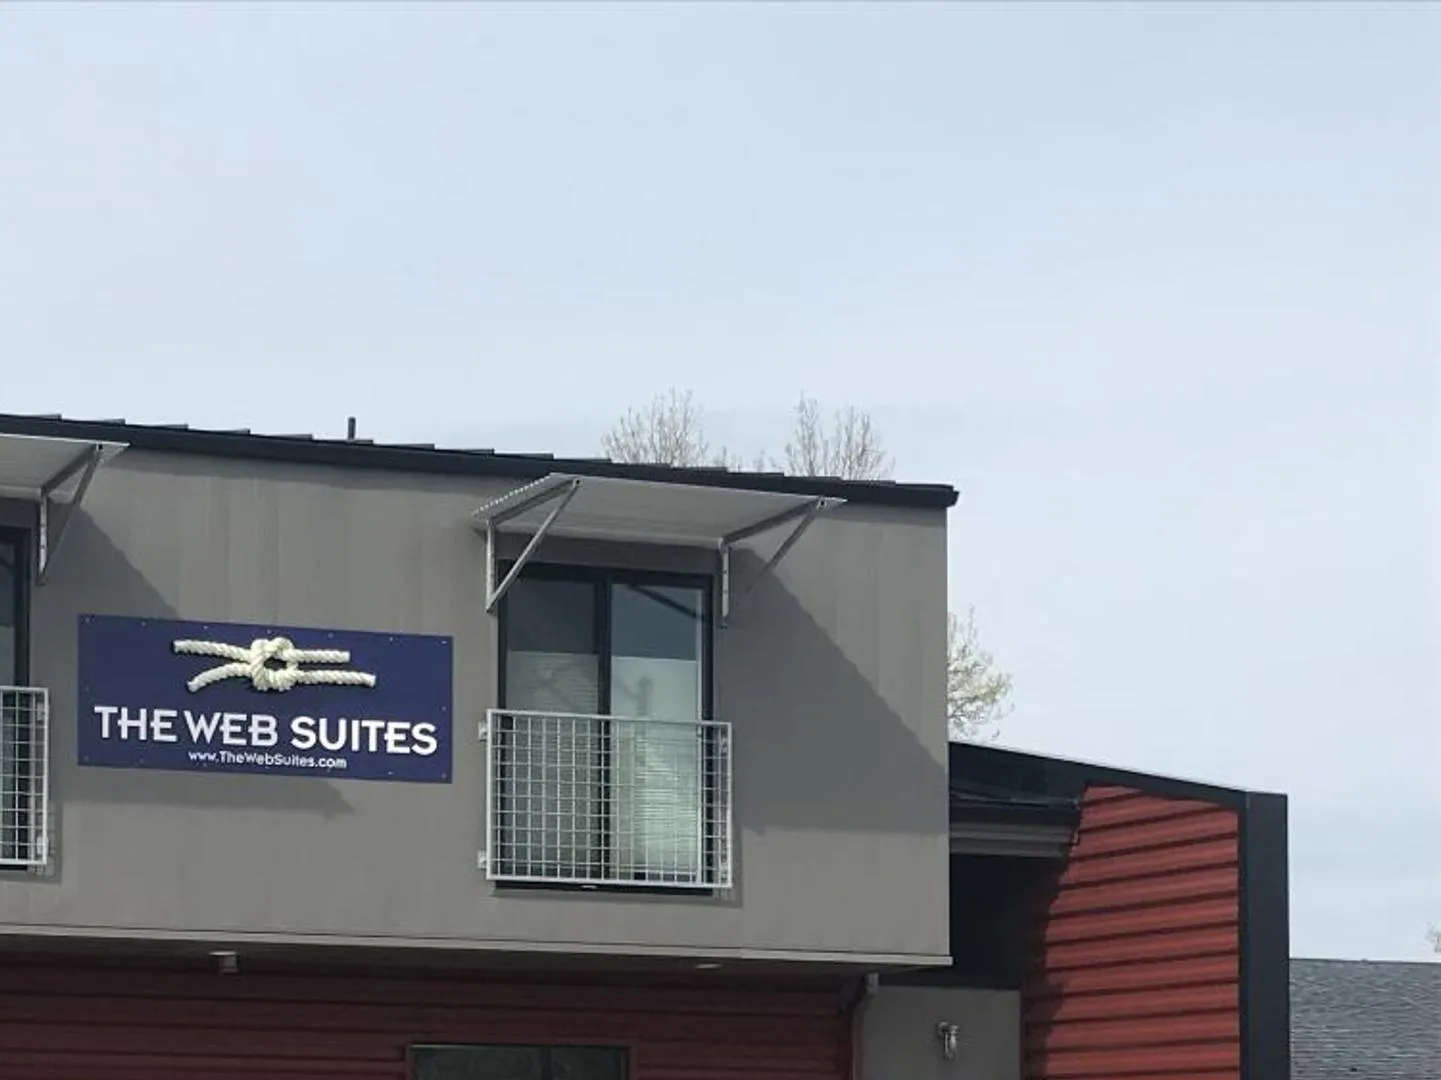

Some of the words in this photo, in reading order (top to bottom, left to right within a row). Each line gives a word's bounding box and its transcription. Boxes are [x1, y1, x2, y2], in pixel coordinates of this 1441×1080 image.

[93, 705, 178, 742] THE
[183, 710, 278, 746] WEB
[290, 716, 437, 755] SUITES
[188, 750, 347, 769] www.TheWebSuites.com
